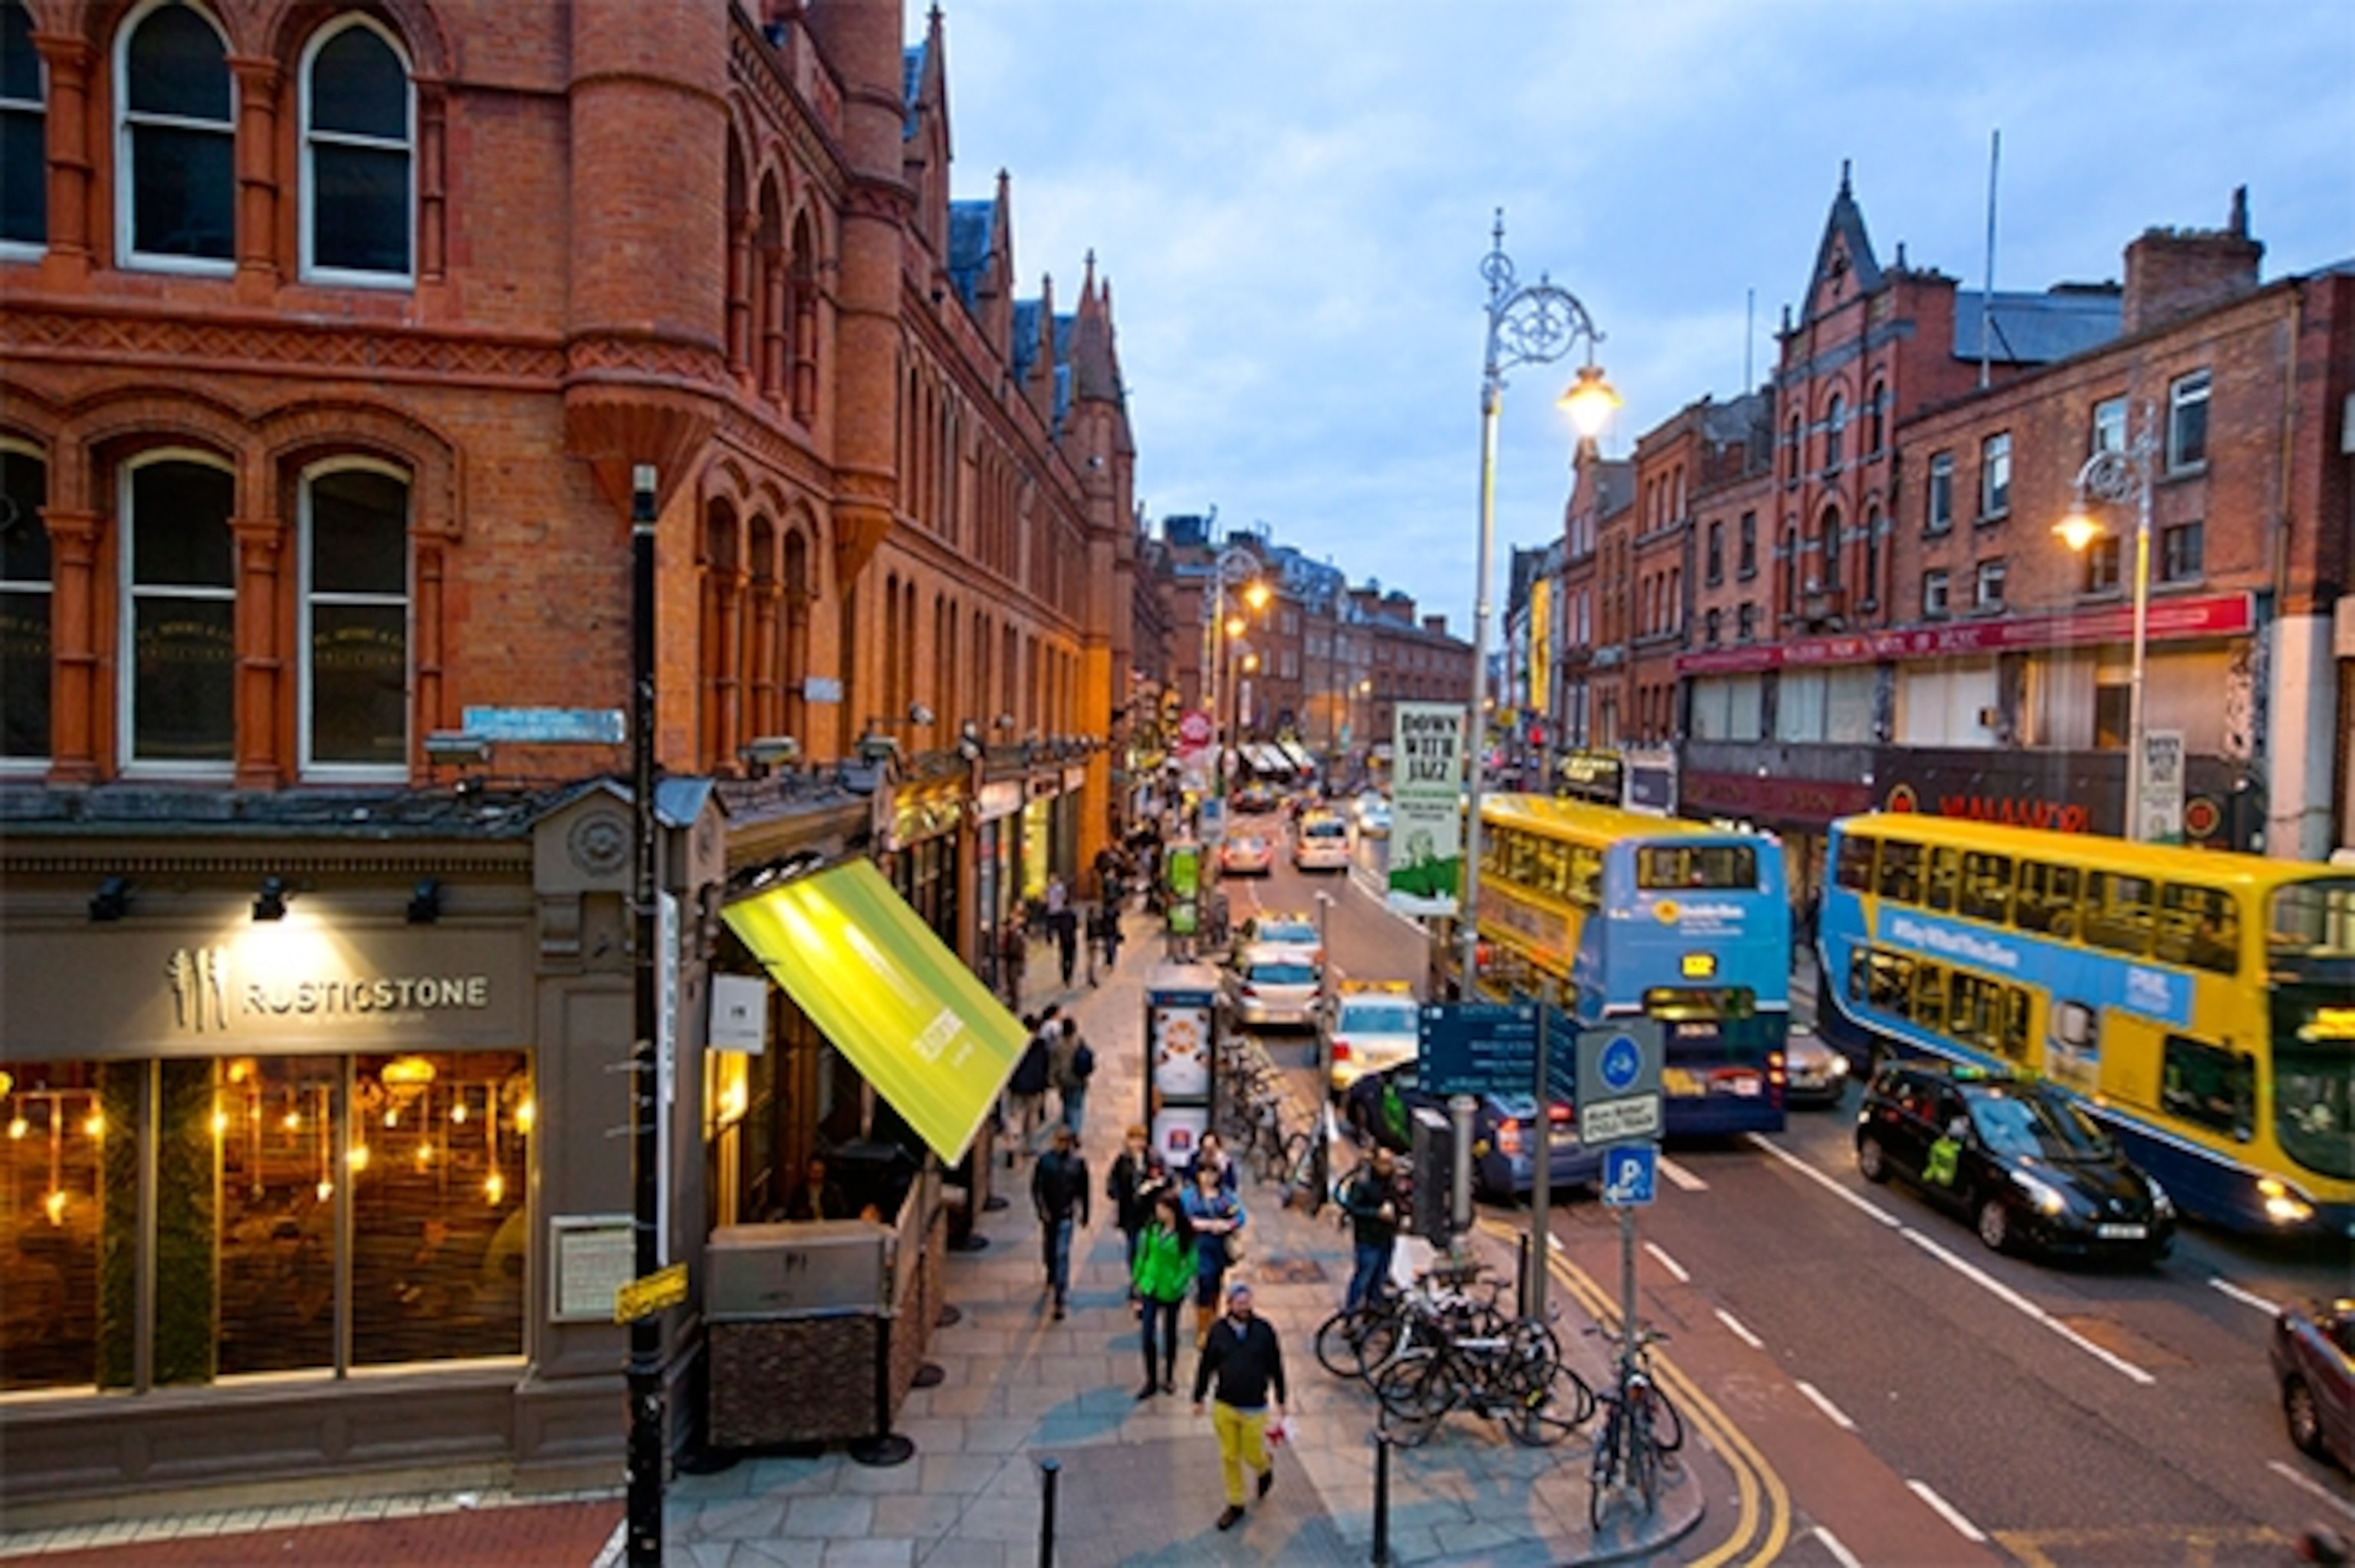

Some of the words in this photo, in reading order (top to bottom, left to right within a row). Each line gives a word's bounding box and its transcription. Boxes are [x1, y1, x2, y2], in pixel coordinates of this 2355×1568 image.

[1402, 713, 1456, 733] DOWN
[1404, 738, 1453, 758] WITH
[1408, 760, 1448, 782] JAZZ
[1620, 1160, 1641, 1186] P
